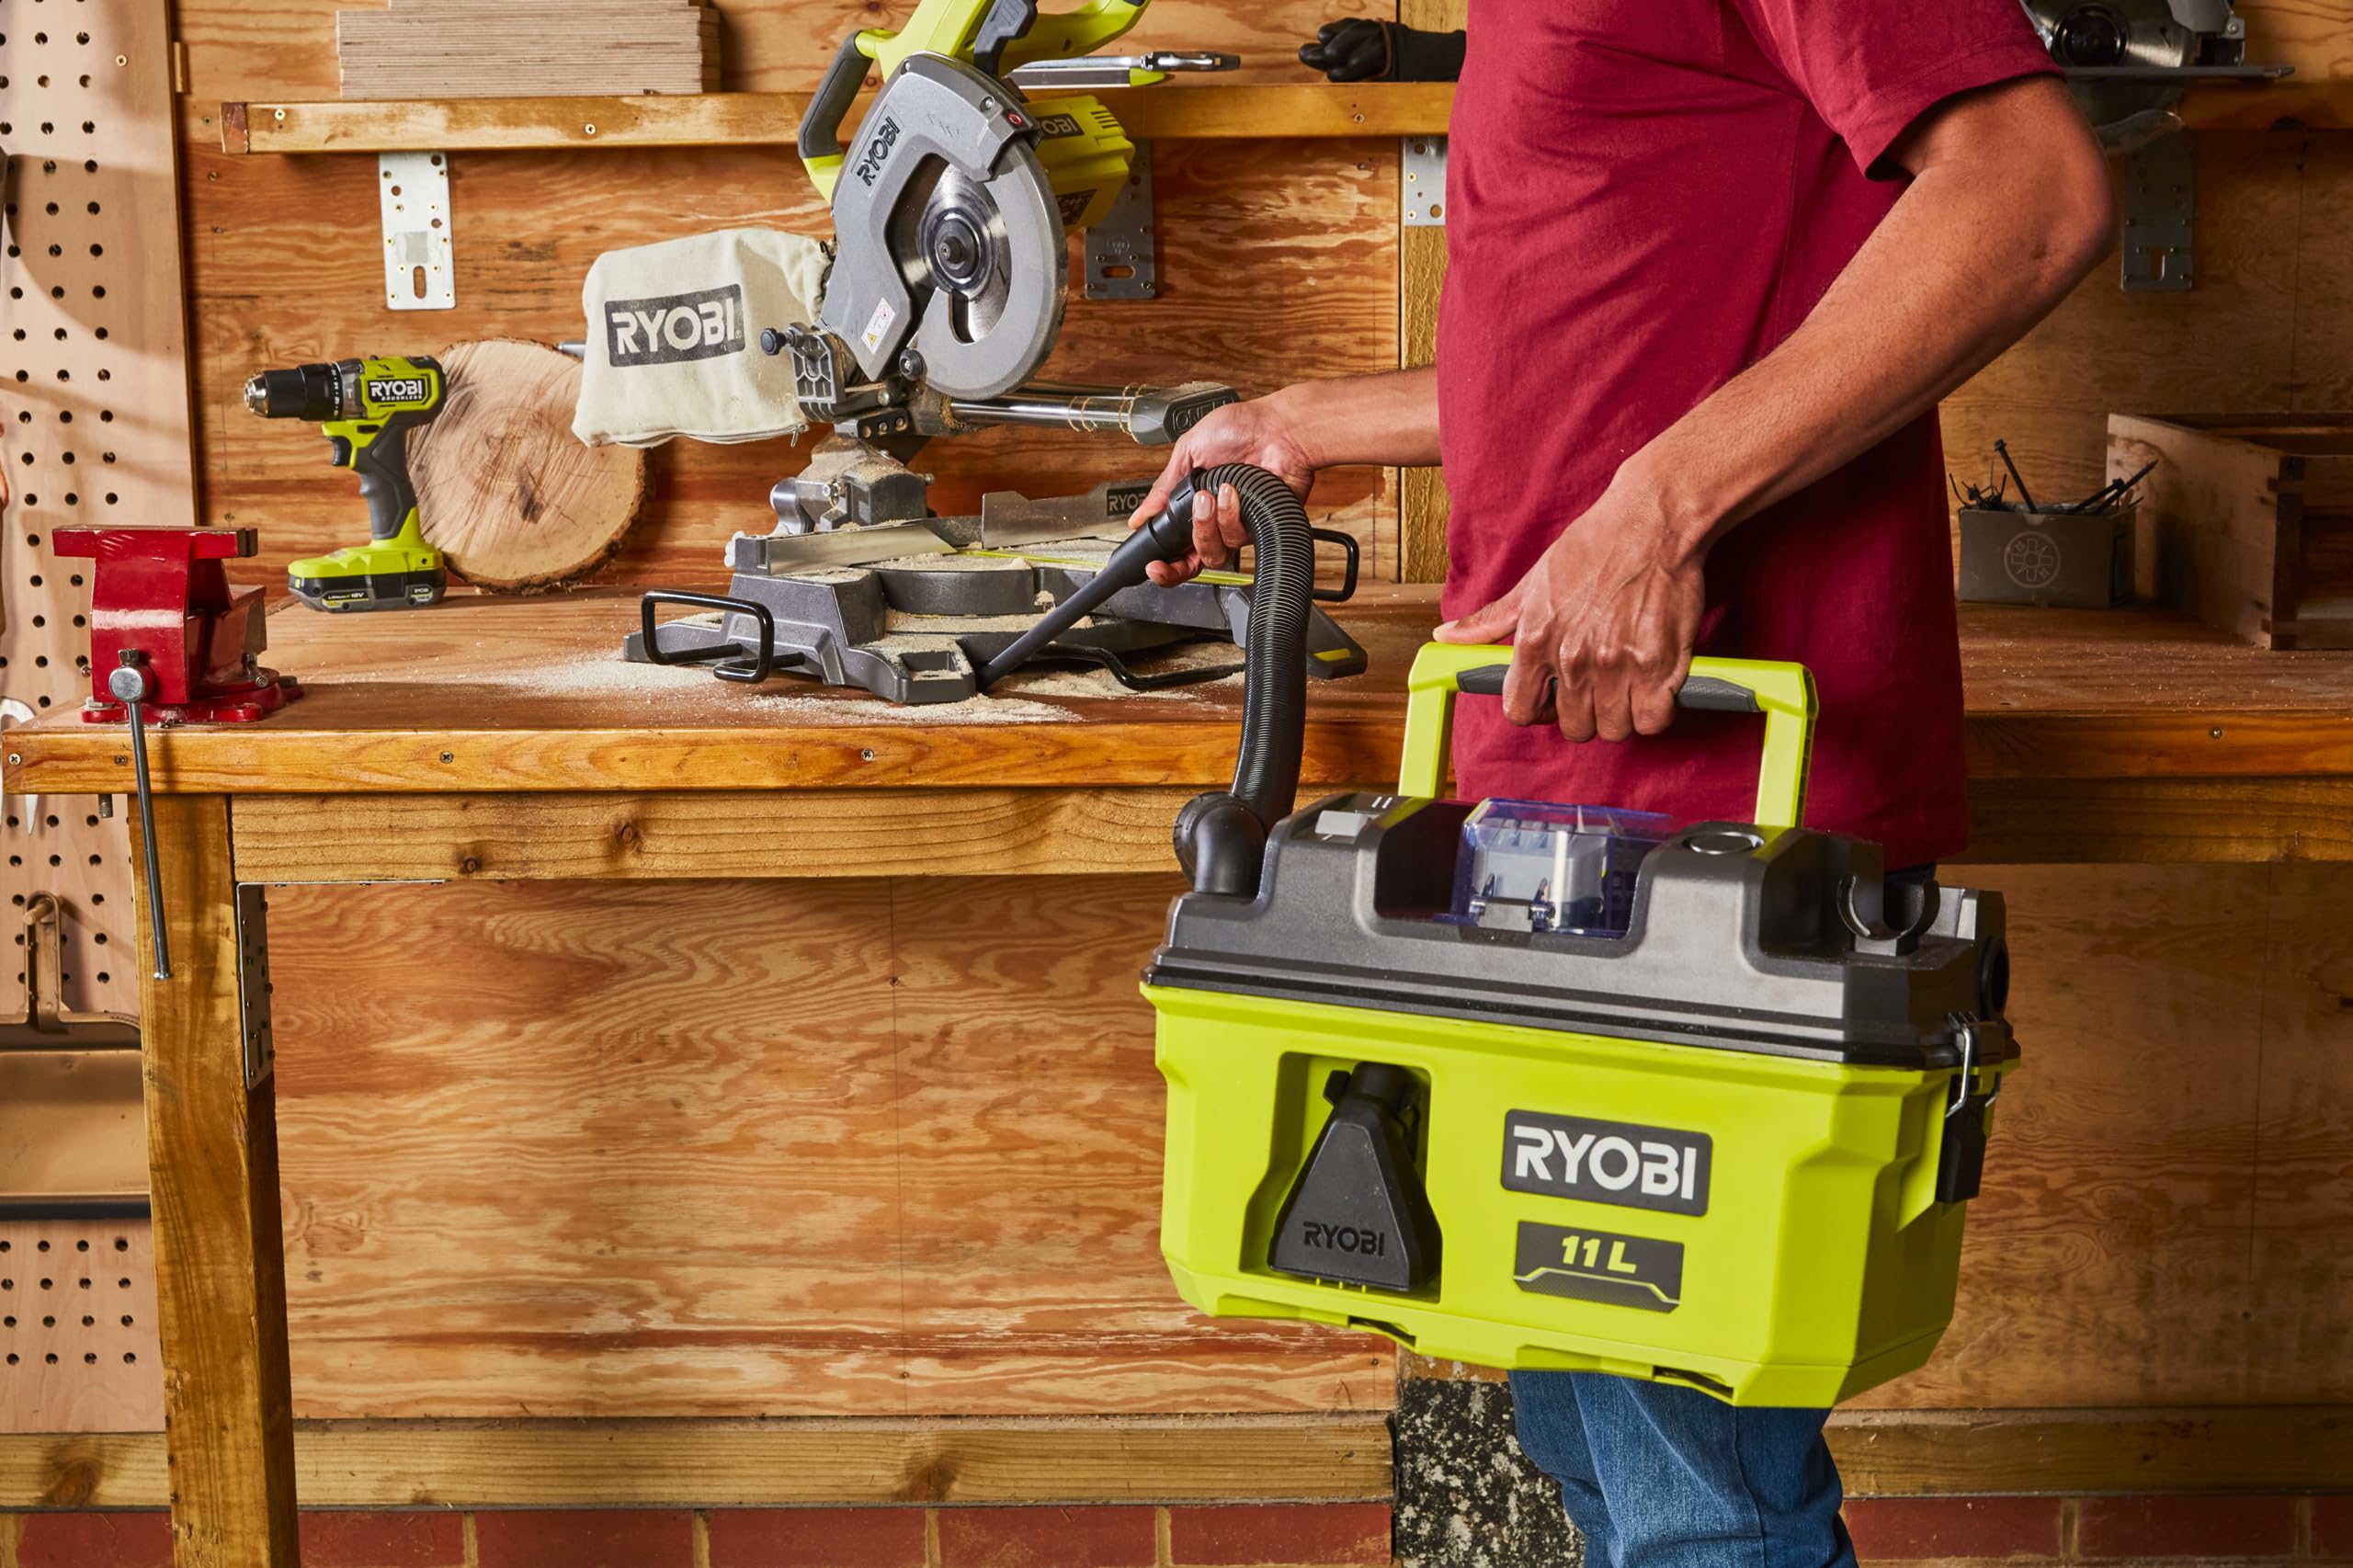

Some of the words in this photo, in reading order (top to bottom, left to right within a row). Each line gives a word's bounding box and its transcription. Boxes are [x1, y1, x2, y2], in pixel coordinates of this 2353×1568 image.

[1040, 118, 1079, 135] OBI
[857, 116, 901, 187] RYOBI
[610, 298, 734, 355] RYOBI
[369, 380, 423, 397] RYOBI
[1108, 494, 1147, 511] RYO
[1514, 1125, 1697, 1199] RYOBI
[1303, 1221, 1385, 1257] RYOBI
[1562, 1235, 1601, 1267] 11
[1607, 1241, 1637, 1274] L
